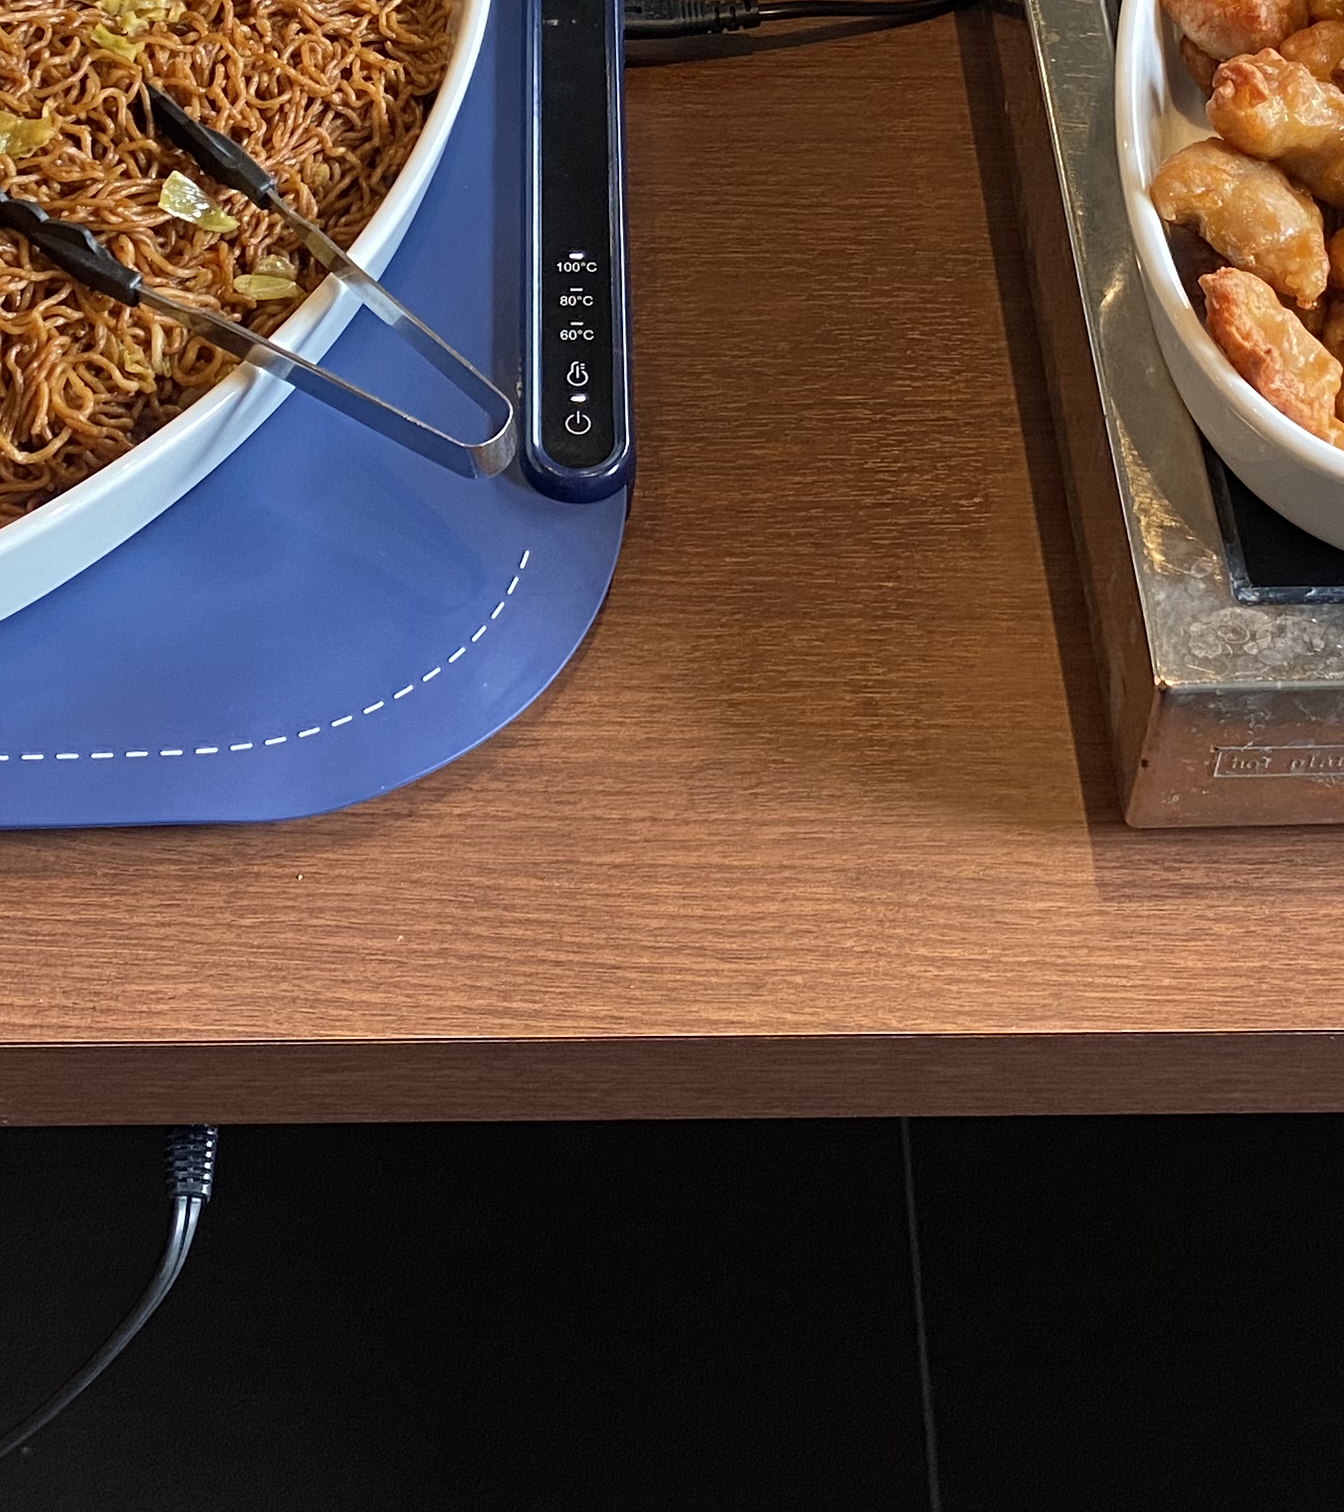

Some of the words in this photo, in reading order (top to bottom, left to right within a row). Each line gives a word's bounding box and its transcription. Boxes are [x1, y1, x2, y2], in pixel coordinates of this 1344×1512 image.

[556, 261, 598, 273] 100°C
[559, 295, 594, 307] 80°C
[559, 329, 594, 341] 60°C
